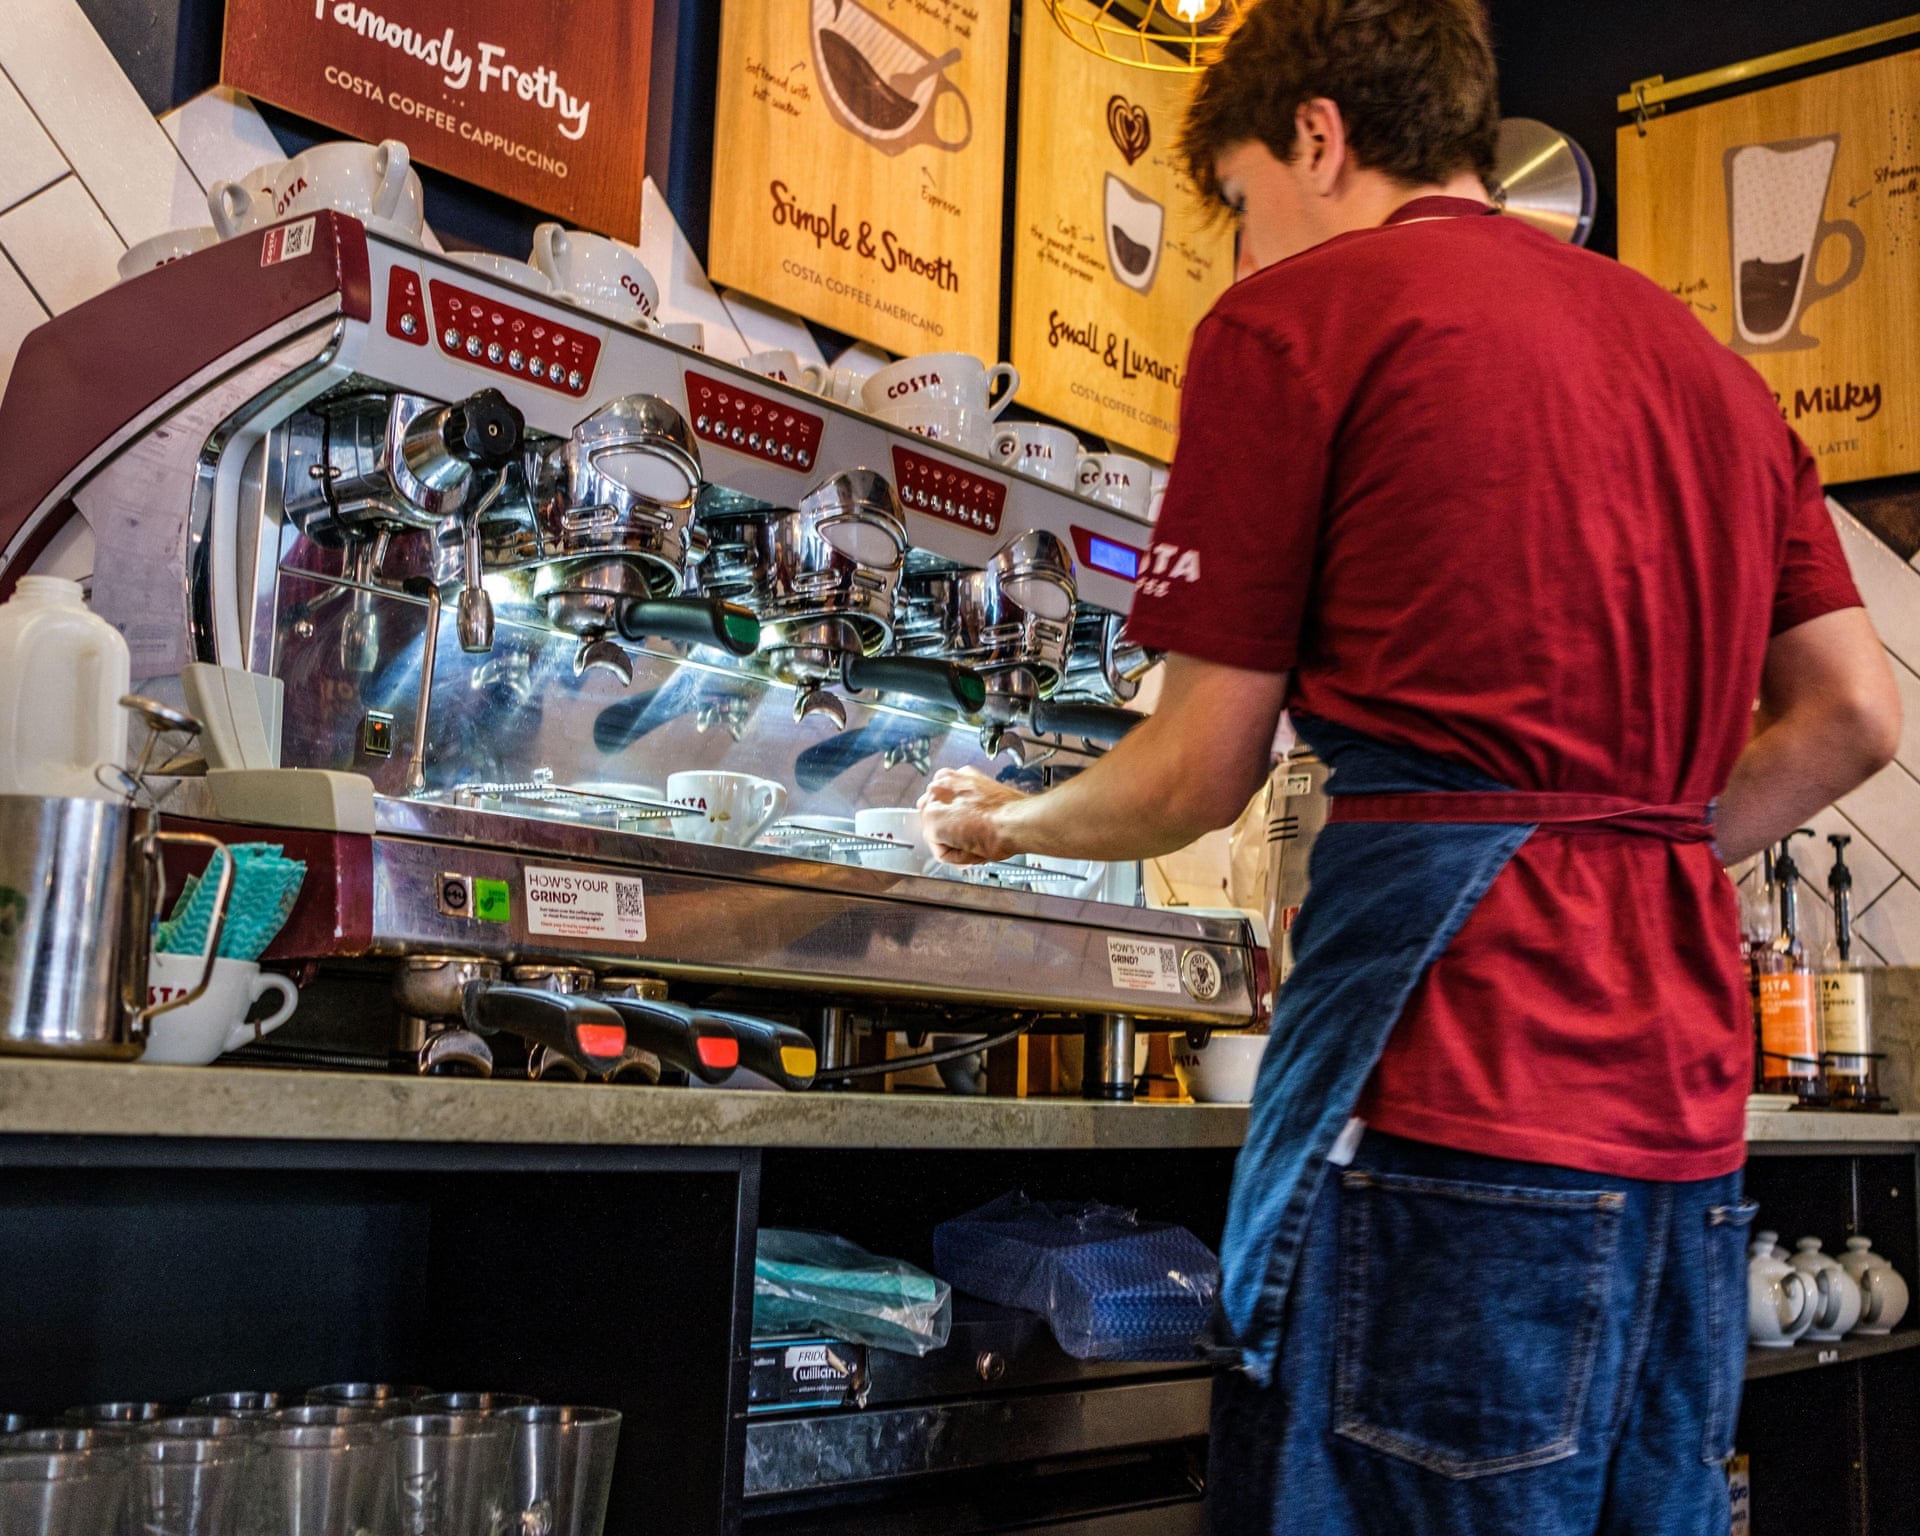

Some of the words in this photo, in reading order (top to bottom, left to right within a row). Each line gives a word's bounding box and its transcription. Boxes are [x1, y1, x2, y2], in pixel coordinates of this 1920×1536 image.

[478, 42, 590, 140] Frothy
[324, 65, 384, 105] COSTA
[388, 92, 456, 133] COFFEE
[459, 121, 568, 178] CAPPUCCINO
[277, 177, 308, 216] OSTA
[770, 180, 851, 249] Simple
[857, 221, 876, 260] &
[881, 230, 959, 293] Smooth
[620, 274, 651, 317] COSTA
[783, 259, 823, 286] COSTA
[826, 277, 873, 308] COFFEE
[875, 298, 944, 338] AMERICANO
[1048, 310, 1100, 355] Small
[1103, 333, 1119, 371] &
[887, 372, 942, 400] COSTA
[1070, 382, 1100, 401] COSTA
[1103, 396, 1137, 419] COFFEE
[1795, 382, 1882, 422] Milky
[1818, 439, 1859, 456] LATTE
[529, 873, 572, 890] HOW'S
[573, 879, 609, 894] YOUR
[530, 889, 578, 905] GRIND?
[1110, 943, 1135, 954] HOW'S
[1136, 946, 1156, 957] YOUR
[1111, 955, 1139, 966] GRIND?
